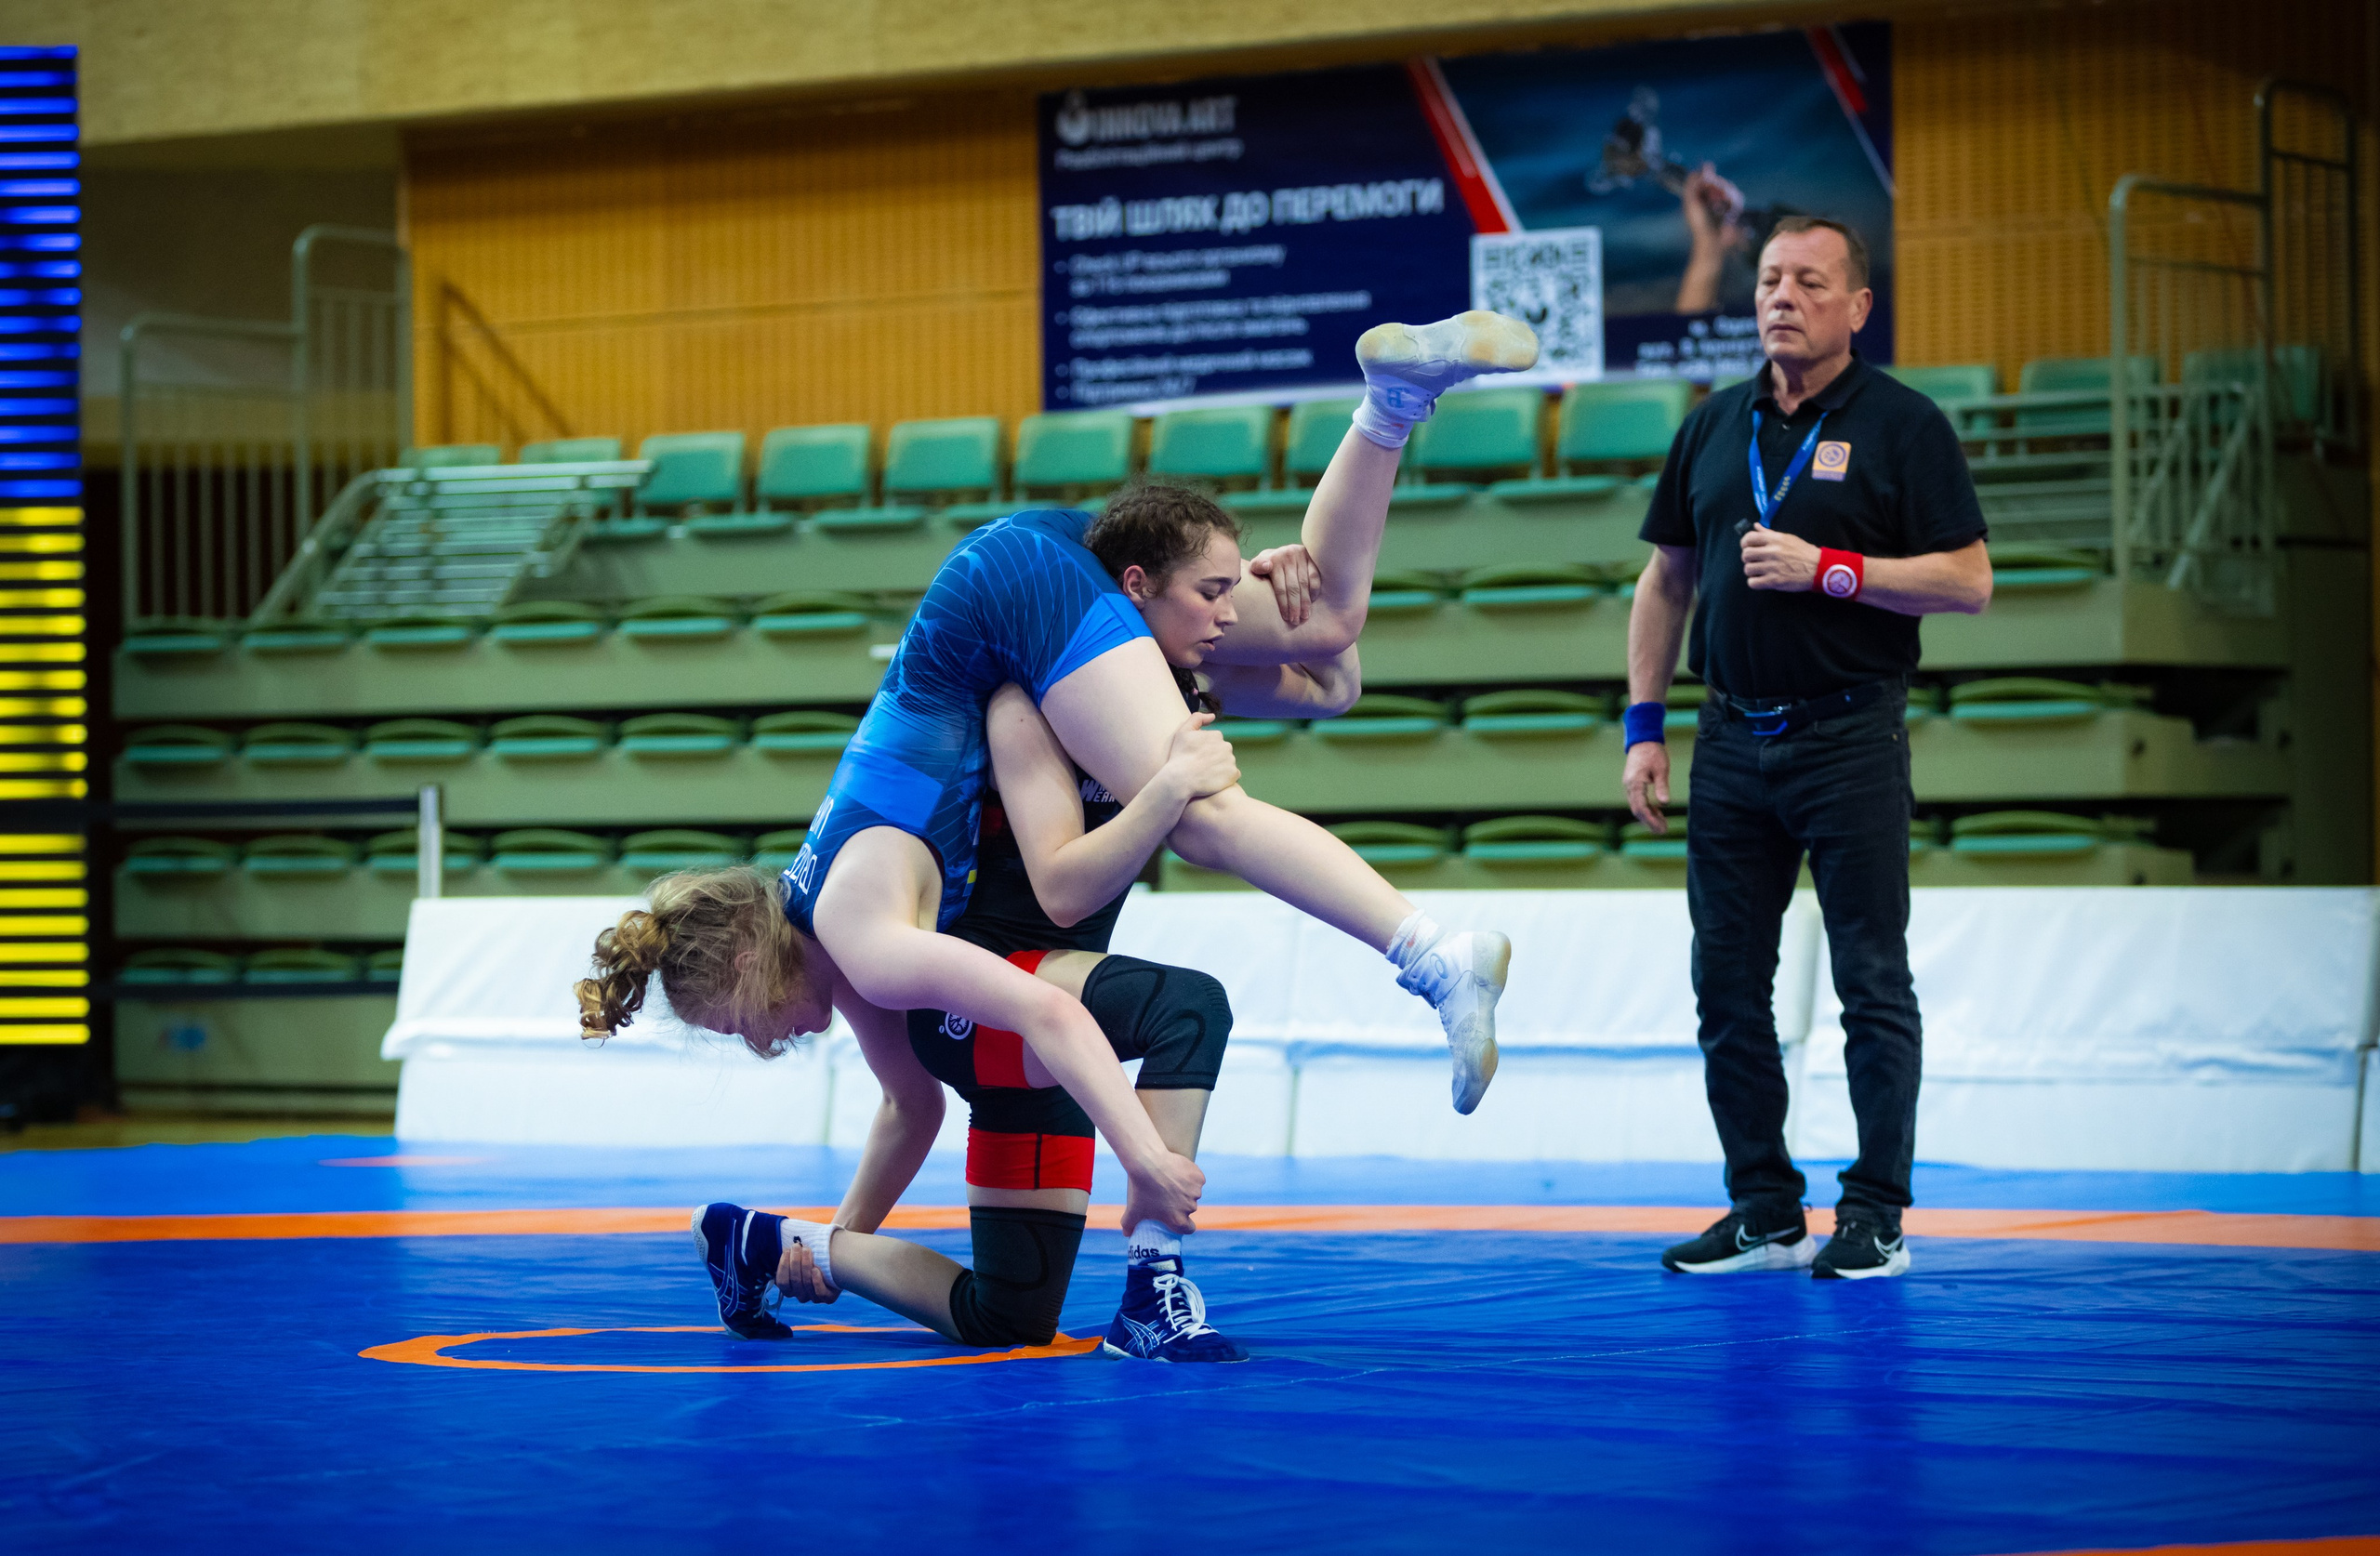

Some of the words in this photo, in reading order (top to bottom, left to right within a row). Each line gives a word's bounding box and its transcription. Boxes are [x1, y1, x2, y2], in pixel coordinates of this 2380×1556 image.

[1053, 198, 1119, 241] ТВІЙ
[1128, 197, 1216, 233] ШЛЯХ
[1221, 193, 1267, 233] ДО
[1274, 179, 1443, 224] ПЕРЕМОГИ
